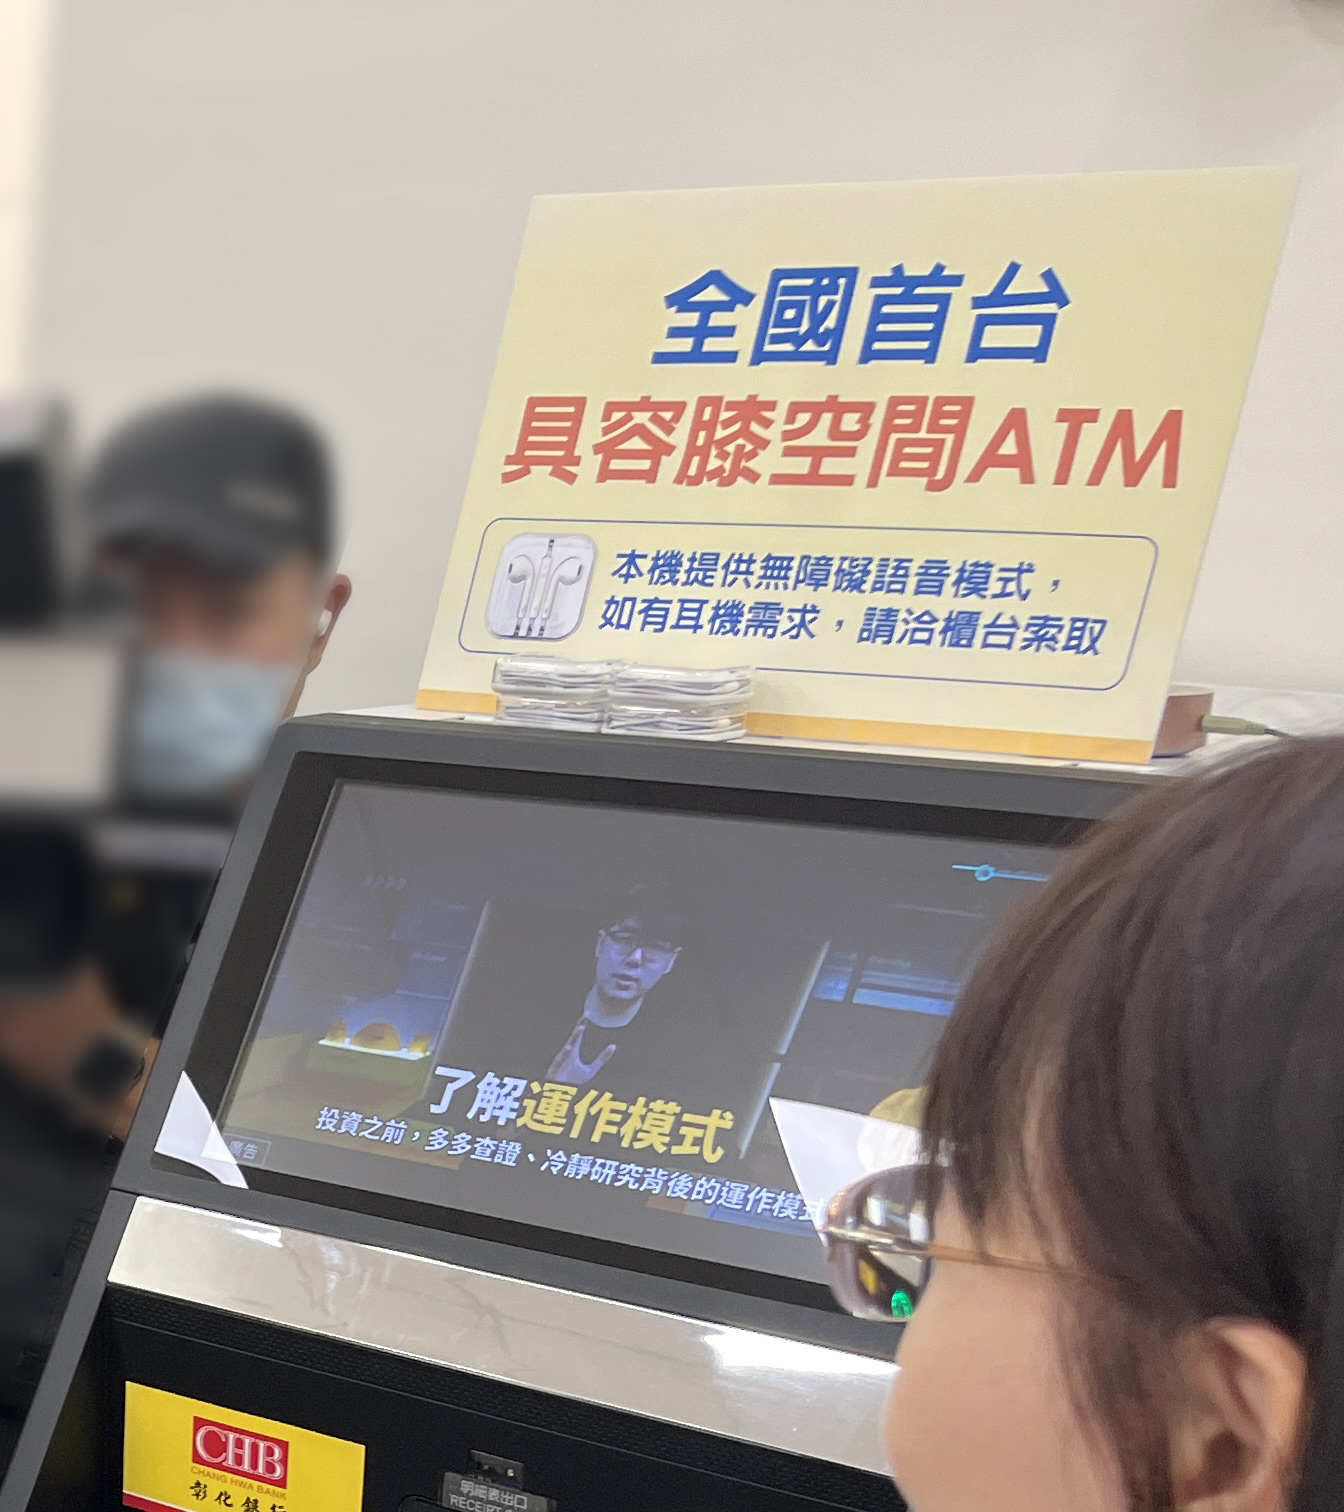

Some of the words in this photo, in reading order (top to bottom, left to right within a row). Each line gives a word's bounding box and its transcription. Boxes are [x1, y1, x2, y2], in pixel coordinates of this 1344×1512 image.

[650, 259, 1072, 367] 全國首台
[500, 393, 1185, 493] 具容膝空間ATM
[610, 547, 1061, 601] 本機提供無障礙語音模式，
[598, 594, 1108, 657] 如有耳機需求，請洽櫃台索取
[429, 1065, 734, 1165] 了解運作模式
[190, 1465, 228, 1484] CHANG
[229, 1478, 254, 1492] HWA
[256, 1484, 287, 1501] BANK
[194, 1425, 285, 1481] CHB
